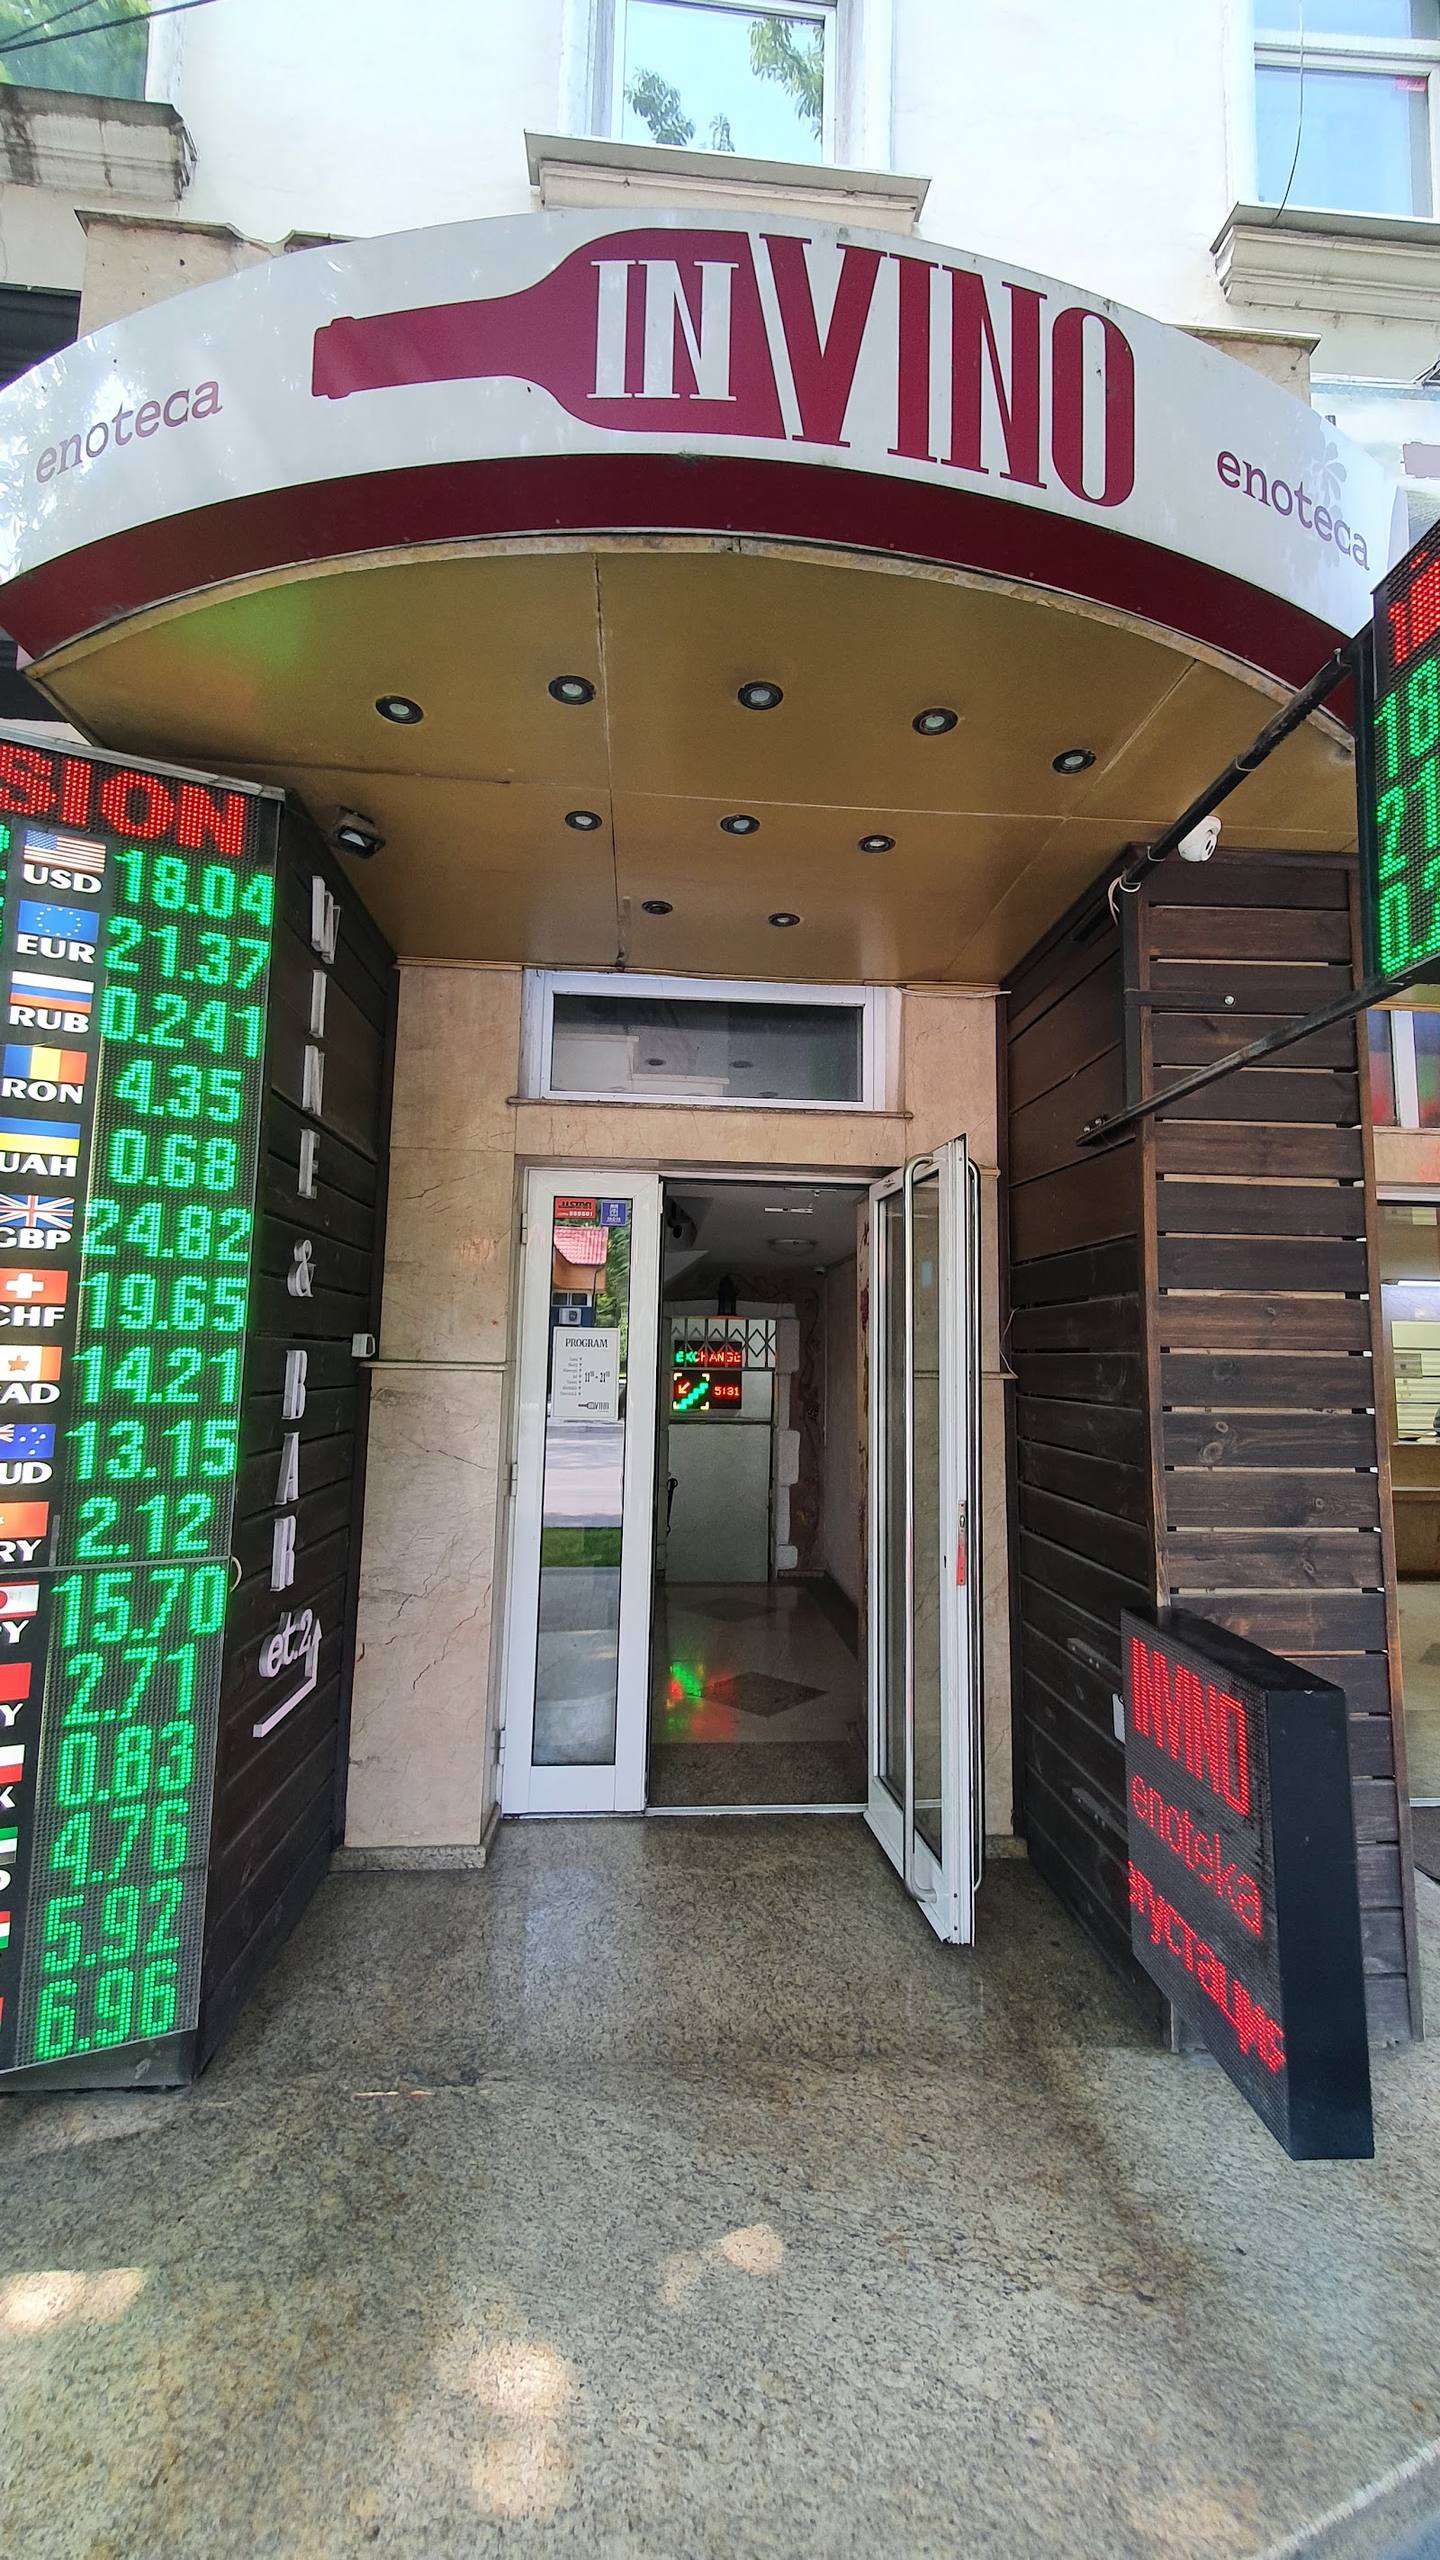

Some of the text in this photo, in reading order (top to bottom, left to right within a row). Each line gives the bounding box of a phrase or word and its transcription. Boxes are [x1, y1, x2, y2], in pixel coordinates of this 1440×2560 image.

[35, 380, 222, 483] enoteca
[1216, 450, 1370, 571] enoteca
[23, 864, 103, 894] USD
[113, 849, 276, 927] 18.04
[16, 934, 96, 964] EUR
[103, 916, 271, 991] 21.37
[9, 1006, 90, 1034] RUB
[101, 985, 263, 1060] 0.241
[1, 1078, 84, 1105] RON
[114, 1058, 243, 1125] 4.35
[0, 1152, 77, 1178] UAH
[108, 1128, 240, 1192] 0.68
[0, 1226, 72, 1250] GBP
[81, 1198, 251, 1262] 24.82
[286, 1239, 316, 1298] &
[78, 1271, 247, 1332] 19.65
[71, 1345, 239, 1405] 14.21
[565, 1338, 609, 1348] PROGRAM
[0, 1382, 60, 1405] AD
[65, 1418, 239, 1481] 13.15
[269, 1350, 308, 1593] BAR
[76, 1492, 213, 1558] 2.12
[0, 1619, 30, 1644] Y
[52, 1565, 227, 1648] 15.70
[63, 1642, 196, 1728] 2.71
[56, 1719, 196, 1806] 0.83
[50, 1799, 189, 1887] 4.76
[1131, 1775, 1263, 1937] enoteka
[43, 1876, 184, 1975] 5.92
[35, 1958, 179, 2061] 6.96
